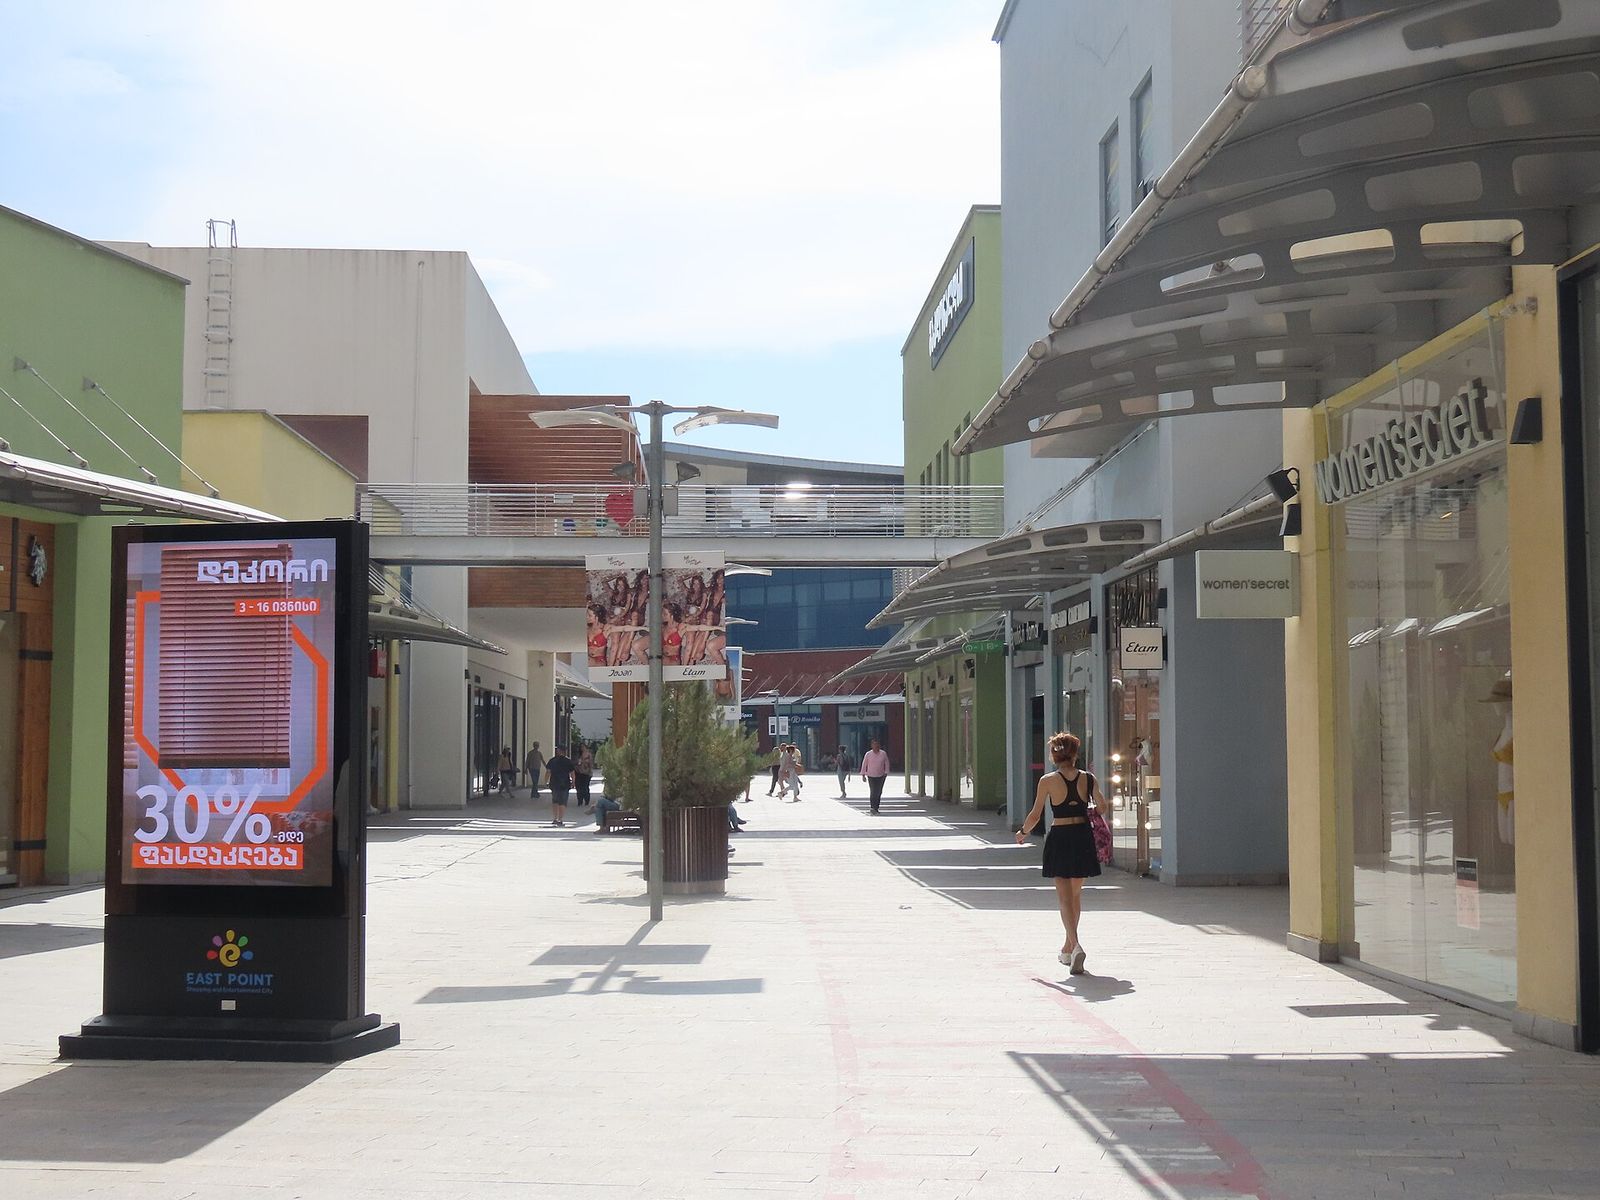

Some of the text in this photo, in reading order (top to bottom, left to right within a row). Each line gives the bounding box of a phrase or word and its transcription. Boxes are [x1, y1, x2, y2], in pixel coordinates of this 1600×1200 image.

[1315, 378, 1488, 503] women'secret
[197, 559, 328, 583] დეკორი
[1203, 578, 1290, 590] women'secret
[257, 602, 269, 612] 16
[272, 601, 317, 612] ივნისი
[1125, 641, 1159, 653] Etam
[682, 668, 706, 676] Etam
[140, 846, 298, 866] ფასდაკლება
[186, 972, 274, 986] EAST POINT
